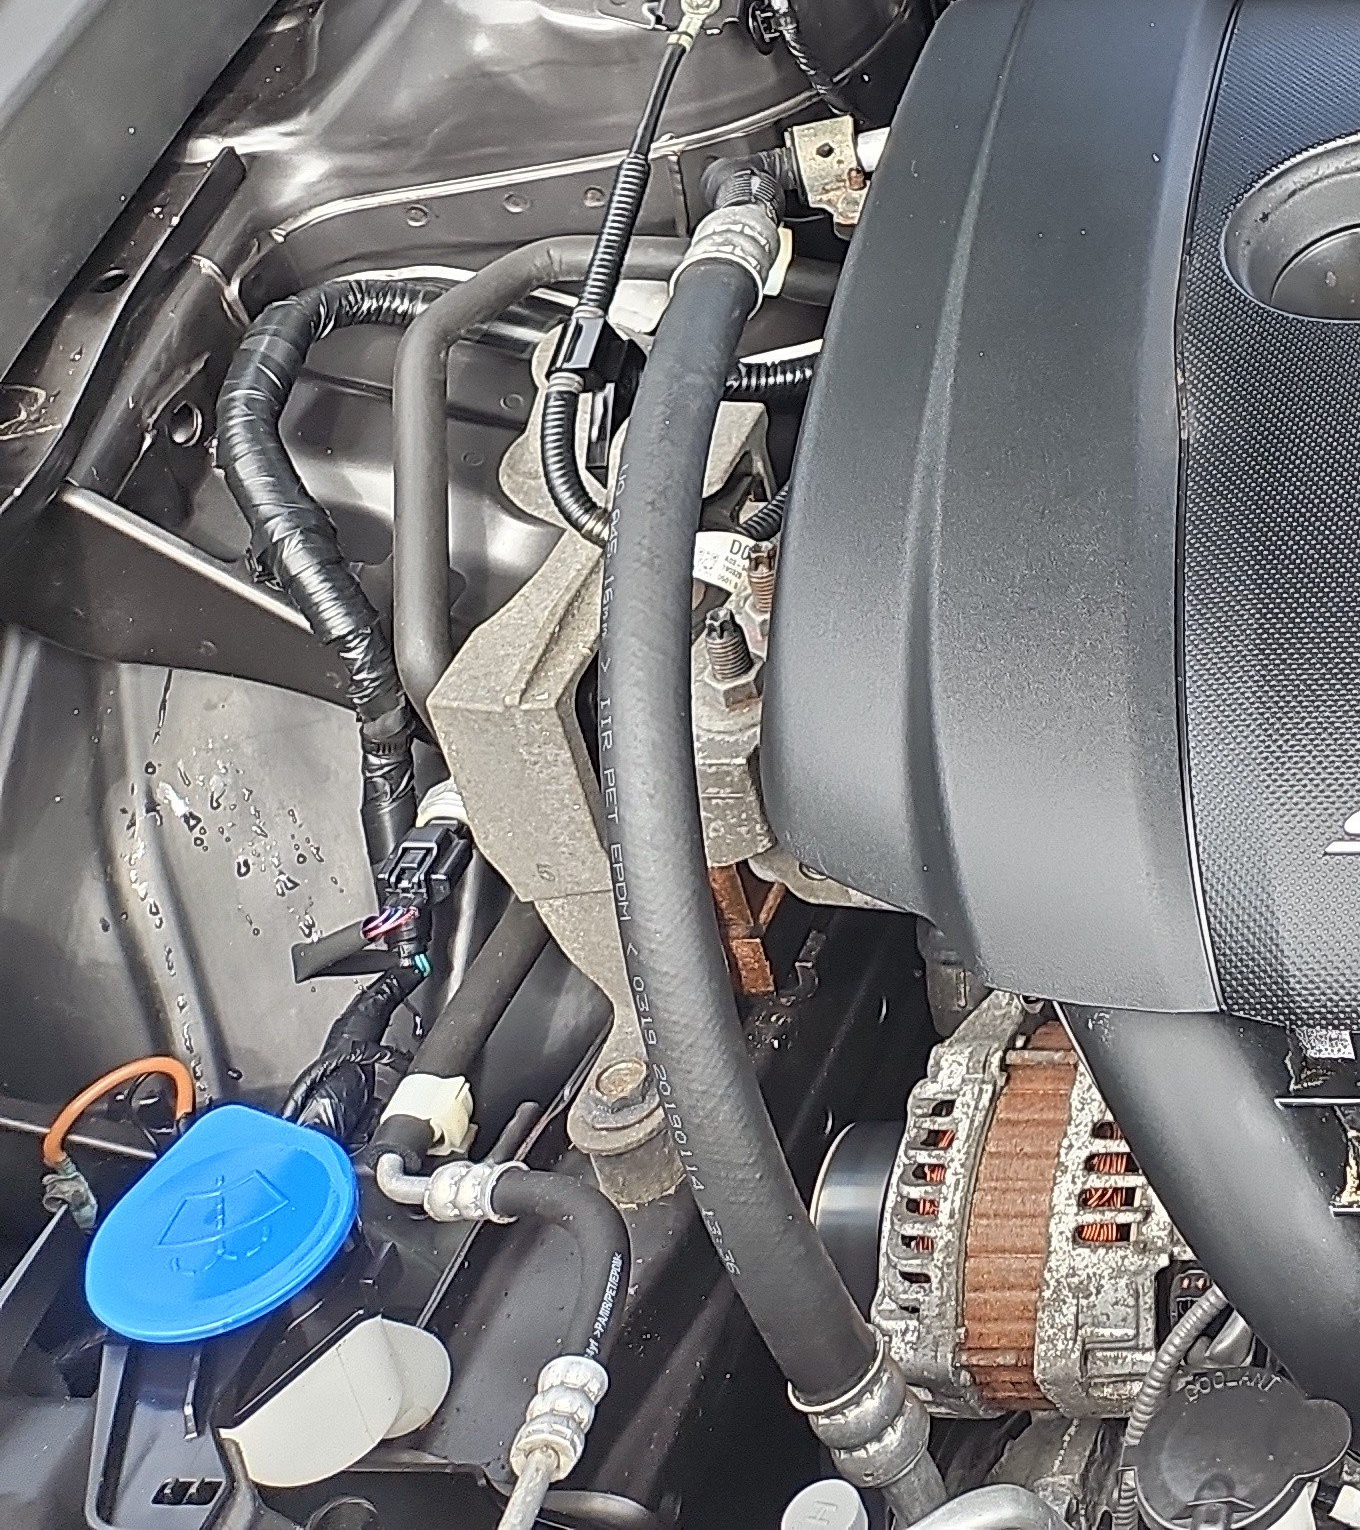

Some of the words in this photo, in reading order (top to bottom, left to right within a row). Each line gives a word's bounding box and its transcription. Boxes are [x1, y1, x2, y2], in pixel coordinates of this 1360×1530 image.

[603, 767, 619, 824] PET
[610, 843, 632, 921] EPDM
[632, 975, 657, 1046] 0319
[652, 1062, 705, 1191] 20190114
[1184, 1371, 1282, 1403] COOLANT
